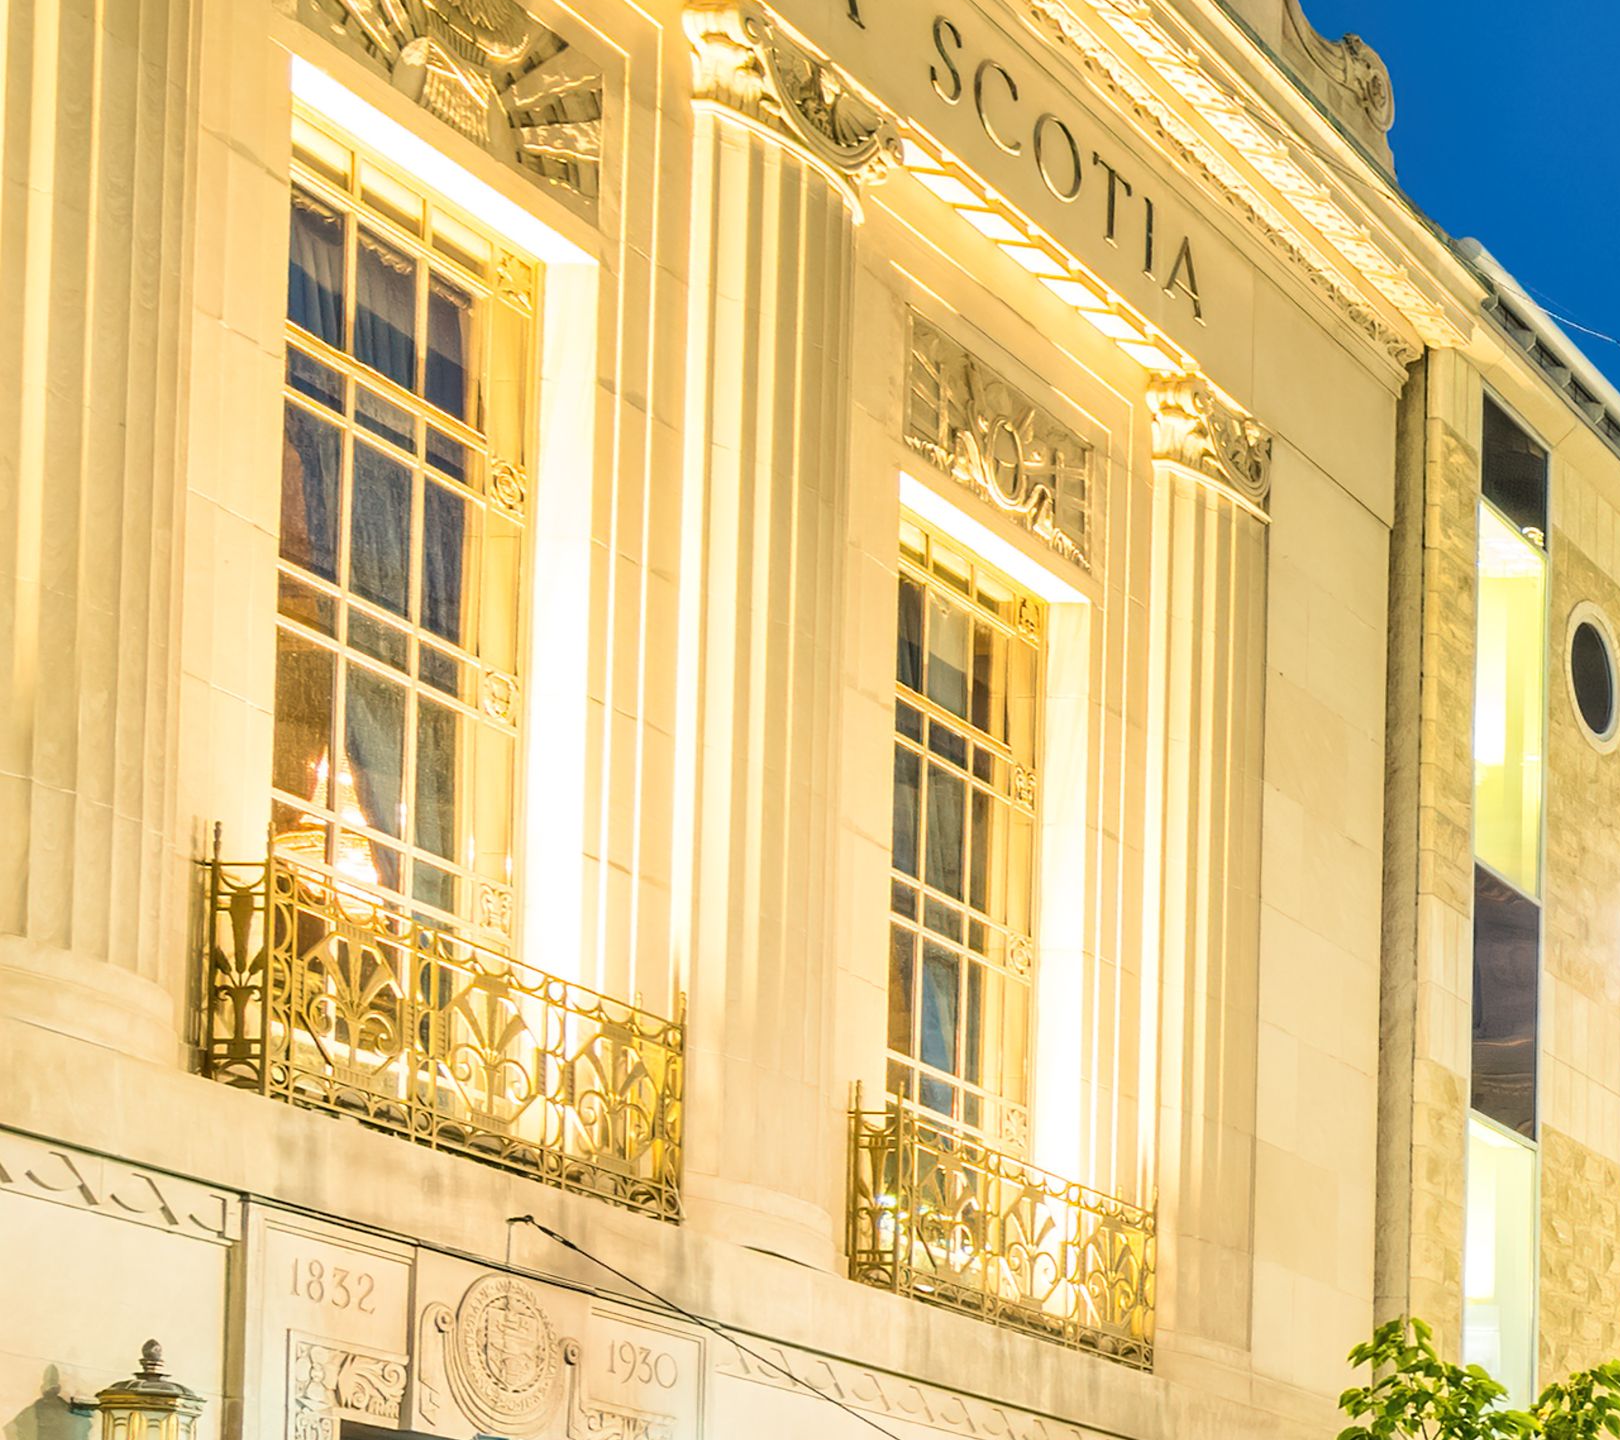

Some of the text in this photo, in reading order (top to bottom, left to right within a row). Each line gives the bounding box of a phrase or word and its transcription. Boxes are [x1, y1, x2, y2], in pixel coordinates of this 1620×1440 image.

[930, 15, 1208, 328] SCOTIA
[291, 1257, 377, 1315] 1832
[608, 1339, 679, 1390] 1930
